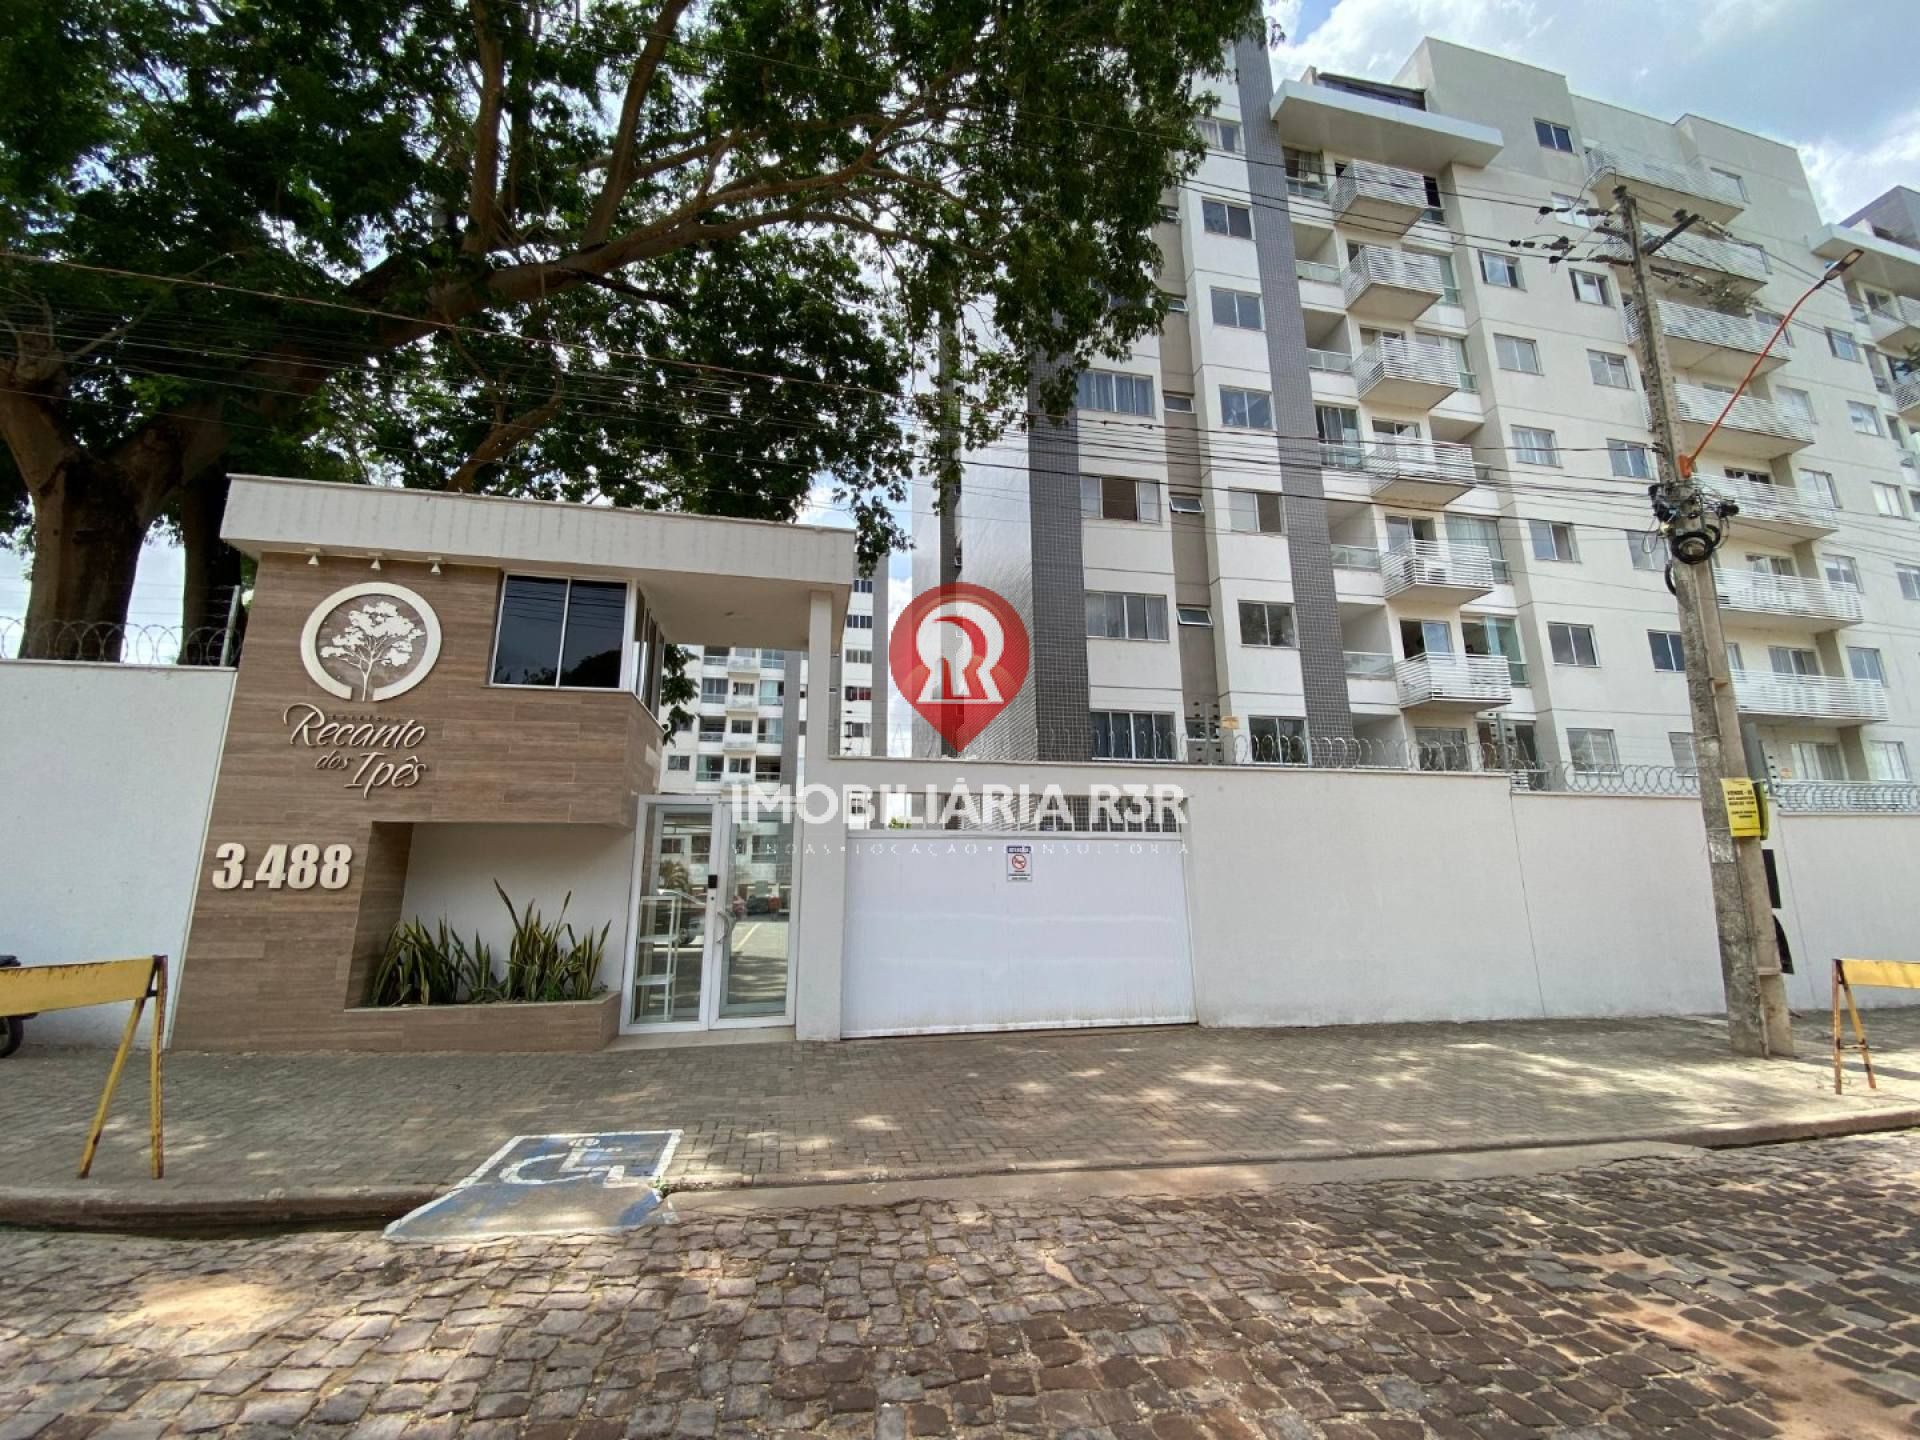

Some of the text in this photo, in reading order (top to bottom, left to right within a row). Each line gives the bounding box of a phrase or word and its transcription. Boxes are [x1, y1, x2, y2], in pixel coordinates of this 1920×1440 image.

[283, 702, 426, 749] Recanto
[315, 750, 428, 799] dos Ipês
[212, 842, 353, 889] 3.488
